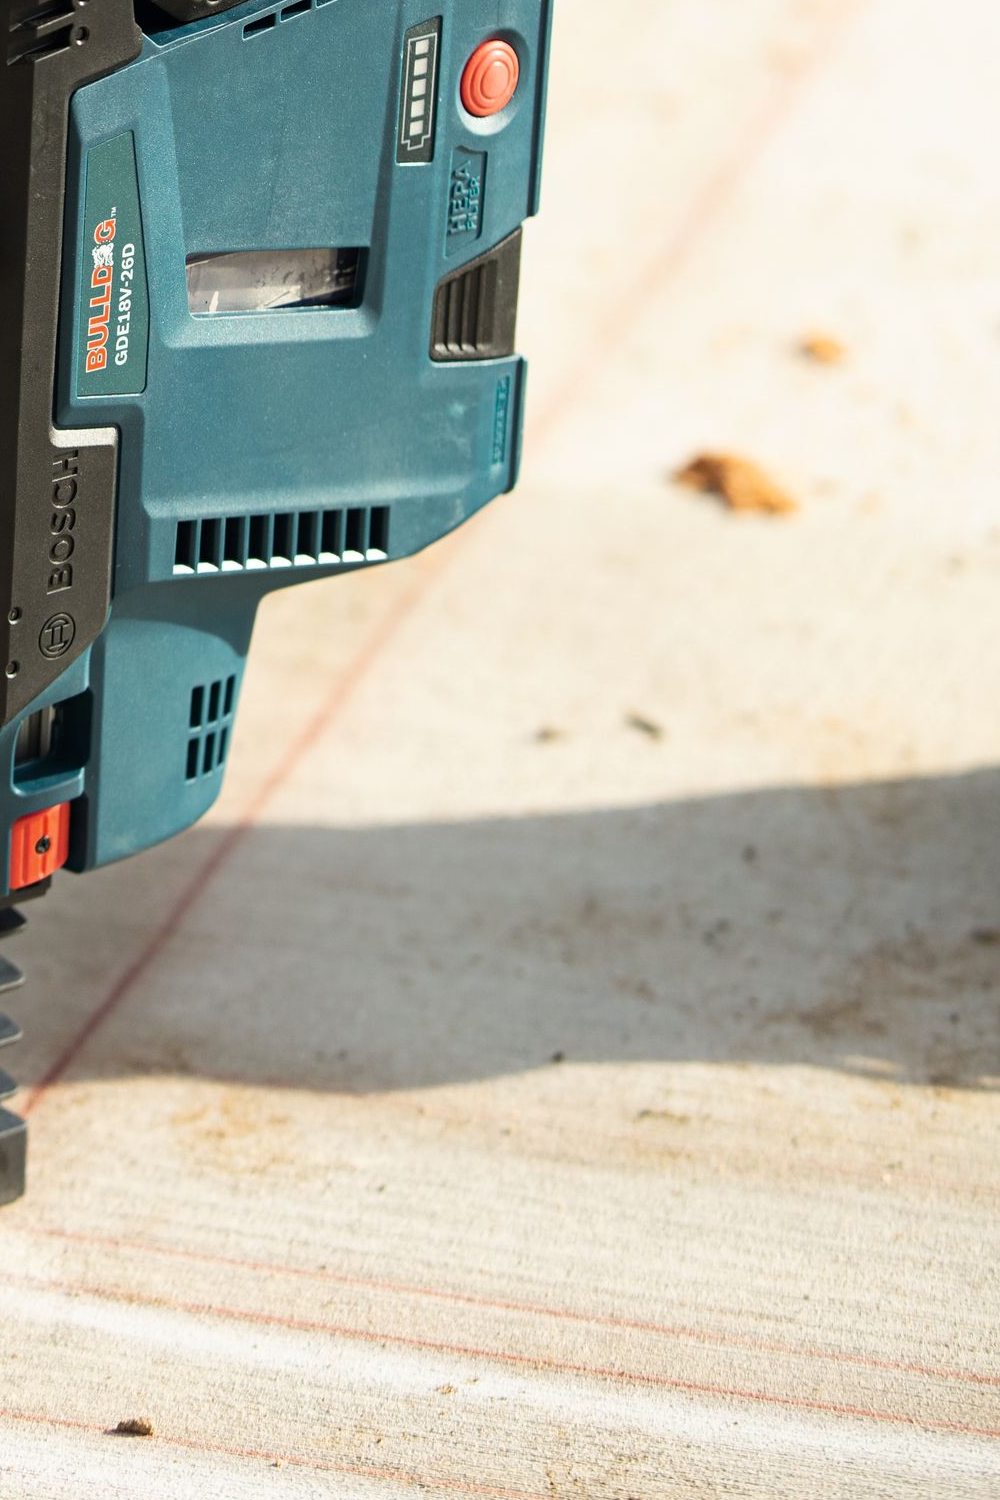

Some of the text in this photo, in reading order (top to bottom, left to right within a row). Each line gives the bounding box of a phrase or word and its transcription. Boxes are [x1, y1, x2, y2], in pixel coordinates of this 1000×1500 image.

[448, 160, 471, 235] HEPA
[85, 217, 117, 373] BULLDG
[114, 243, 135, 366] GDE18V-26D
[47, 449, 79, 595] BOSCH
